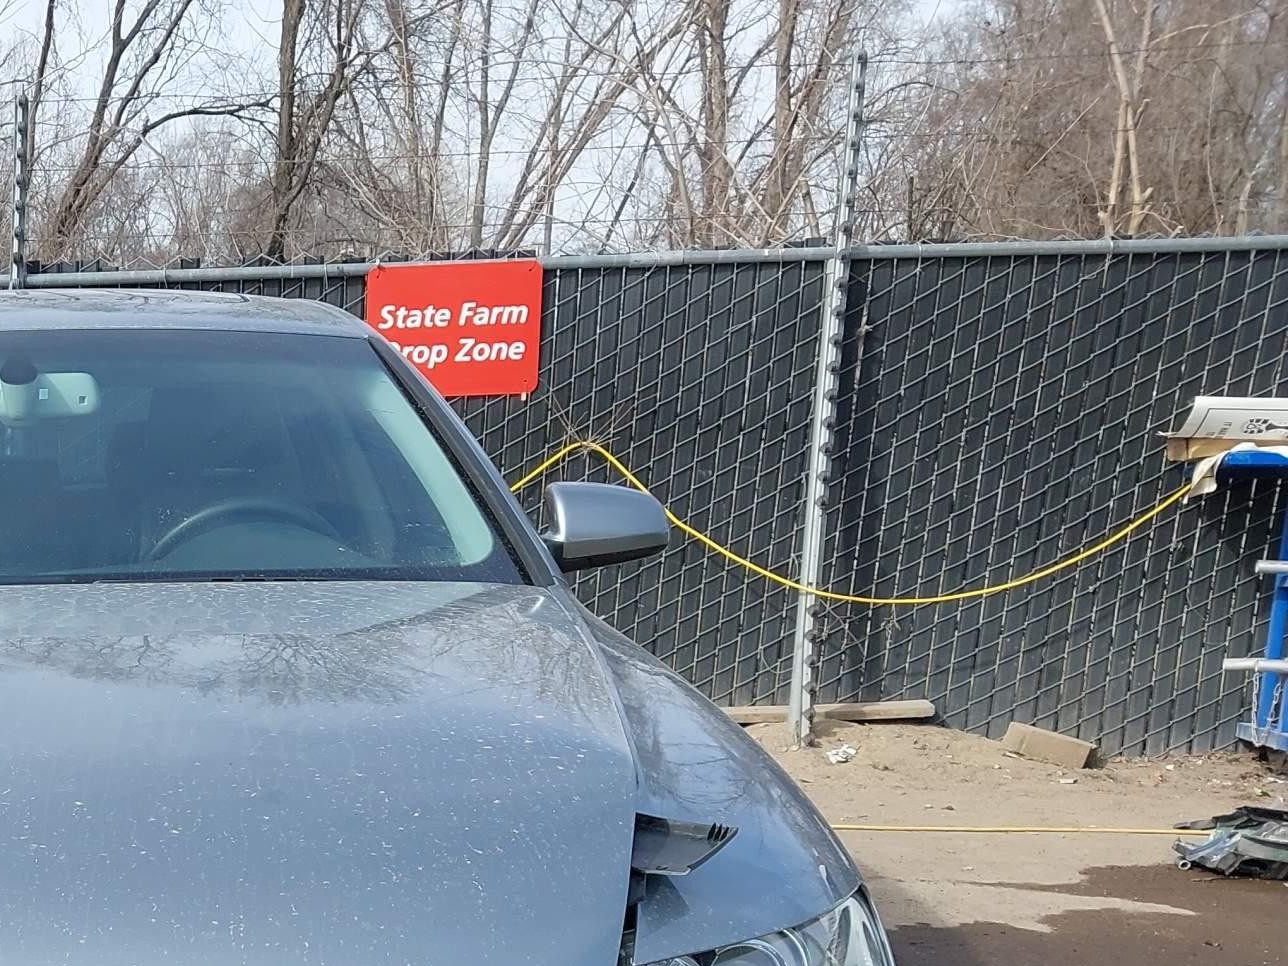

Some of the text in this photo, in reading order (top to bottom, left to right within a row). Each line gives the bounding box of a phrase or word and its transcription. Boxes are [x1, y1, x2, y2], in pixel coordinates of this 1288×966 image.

[378, 301, 529, 330] State Farm
[454, 338, 526, 362] Zone
